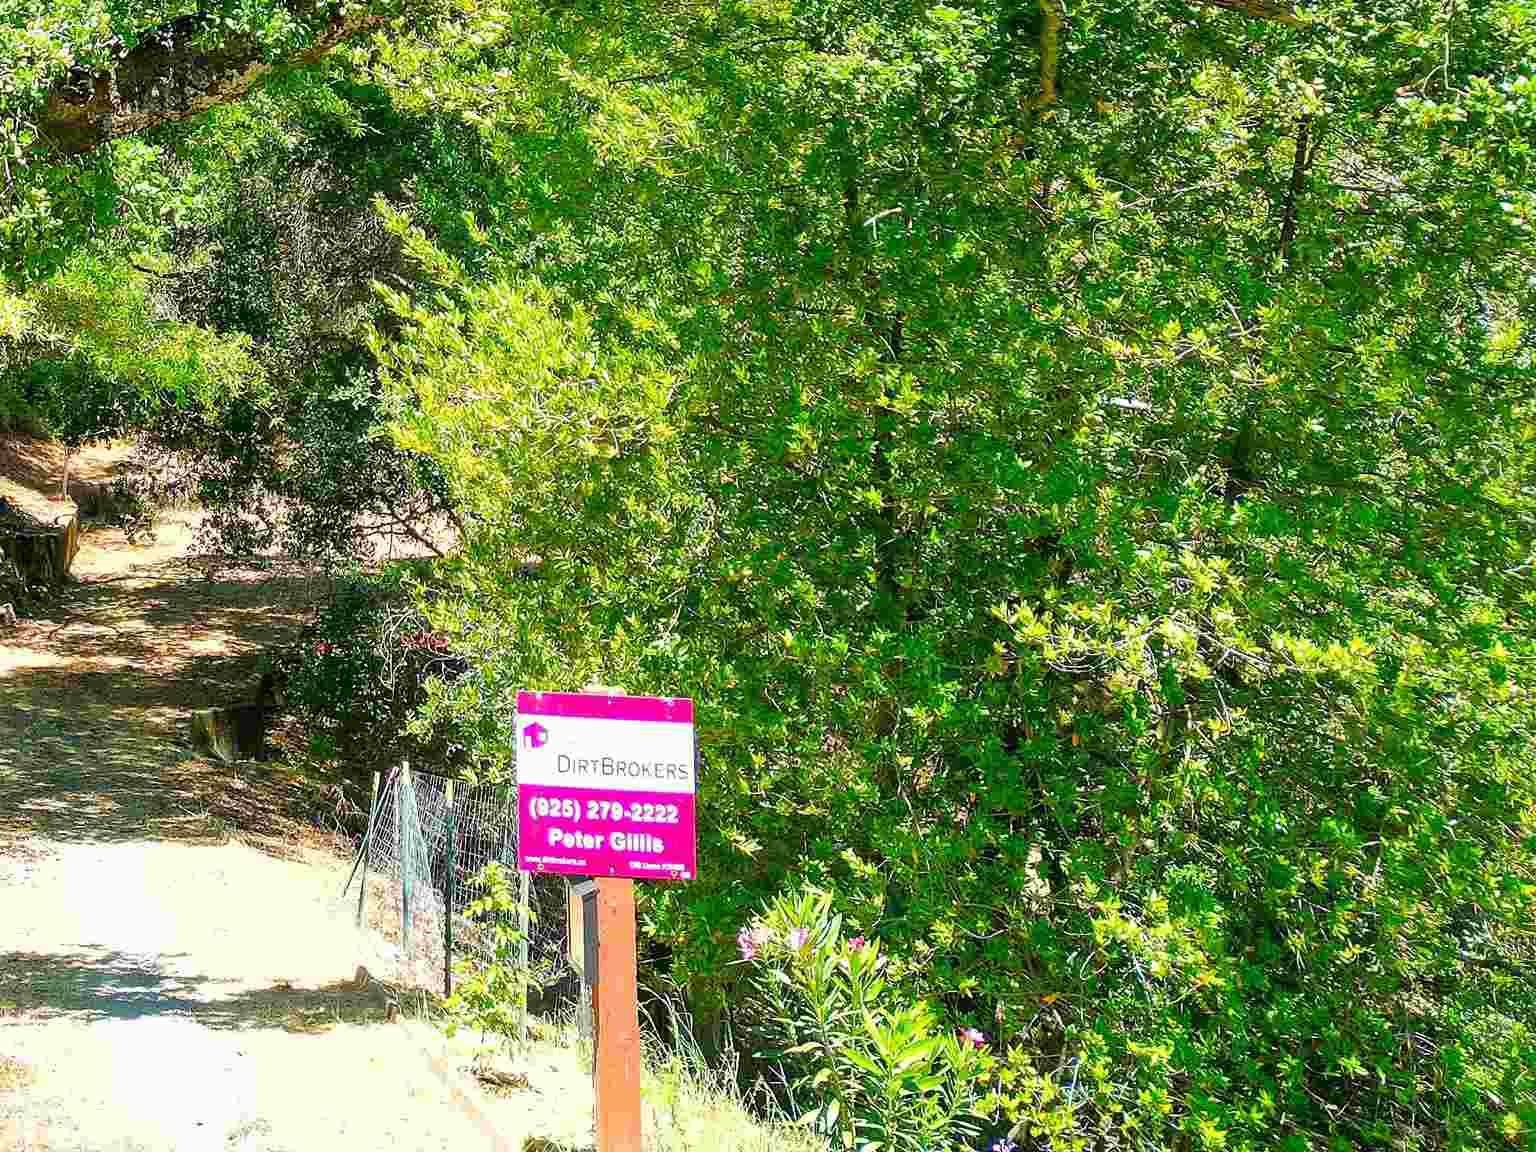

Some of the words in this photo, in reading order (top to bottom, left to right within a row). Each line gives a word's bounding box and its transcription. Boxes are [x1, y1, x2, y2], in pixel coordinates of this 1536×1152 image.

[529, 797, 581, 823] (925)
[586, 800, 679, 824] 279-2222
[548, 827, 605, 849] Peter
[609, 831, 665, 854] Gillis
